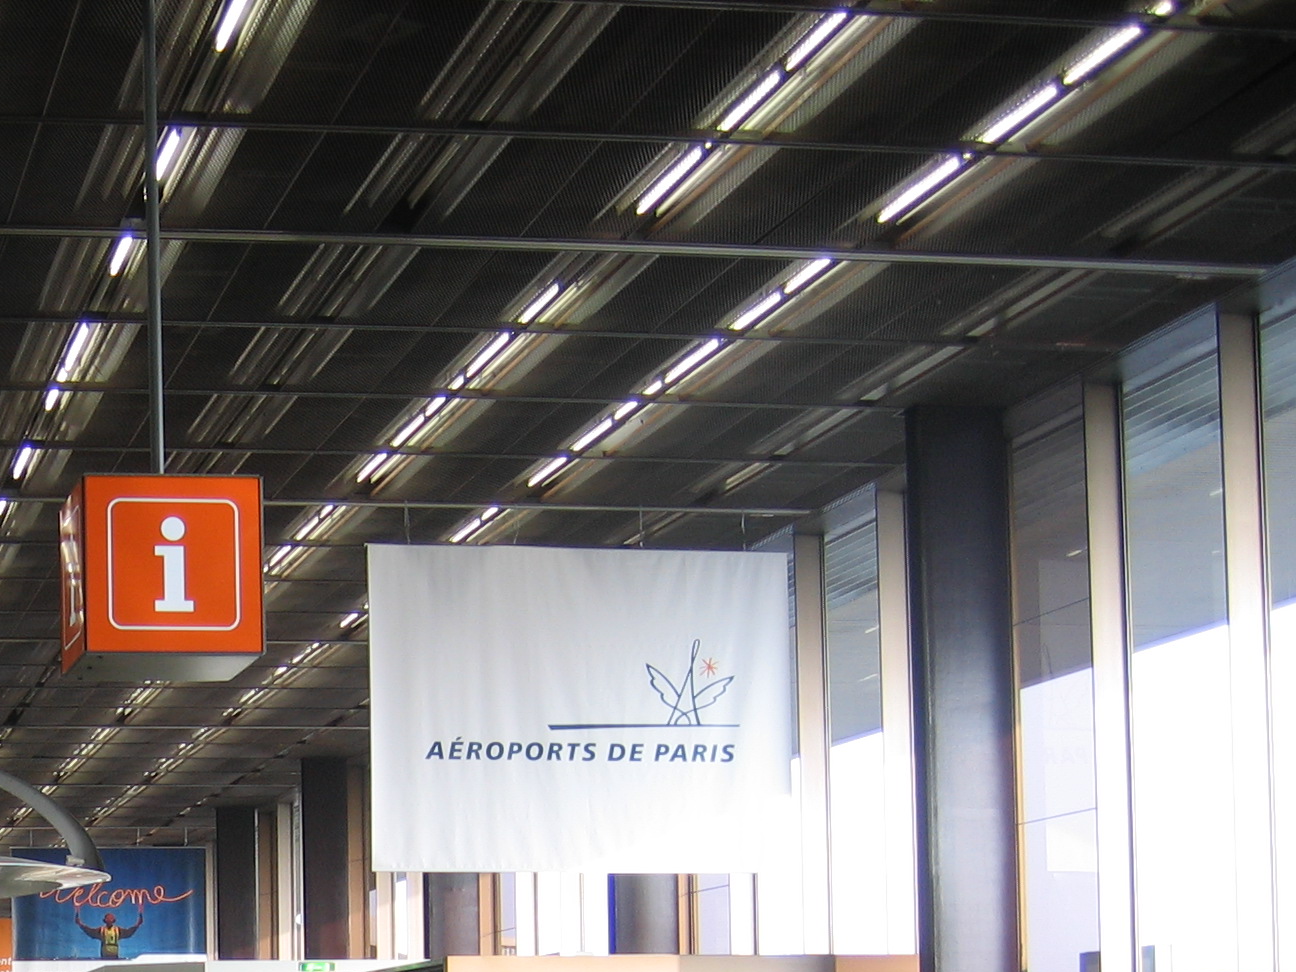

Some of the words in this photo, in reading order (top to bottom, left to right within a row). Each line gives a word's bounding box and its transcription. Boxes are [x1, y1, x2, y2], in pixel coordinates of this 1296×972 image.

[425, 736, 597, 763] AÉROPORTS
[607, 743, 644, 762] DE
[654, 743, 735, 763] PARIS
